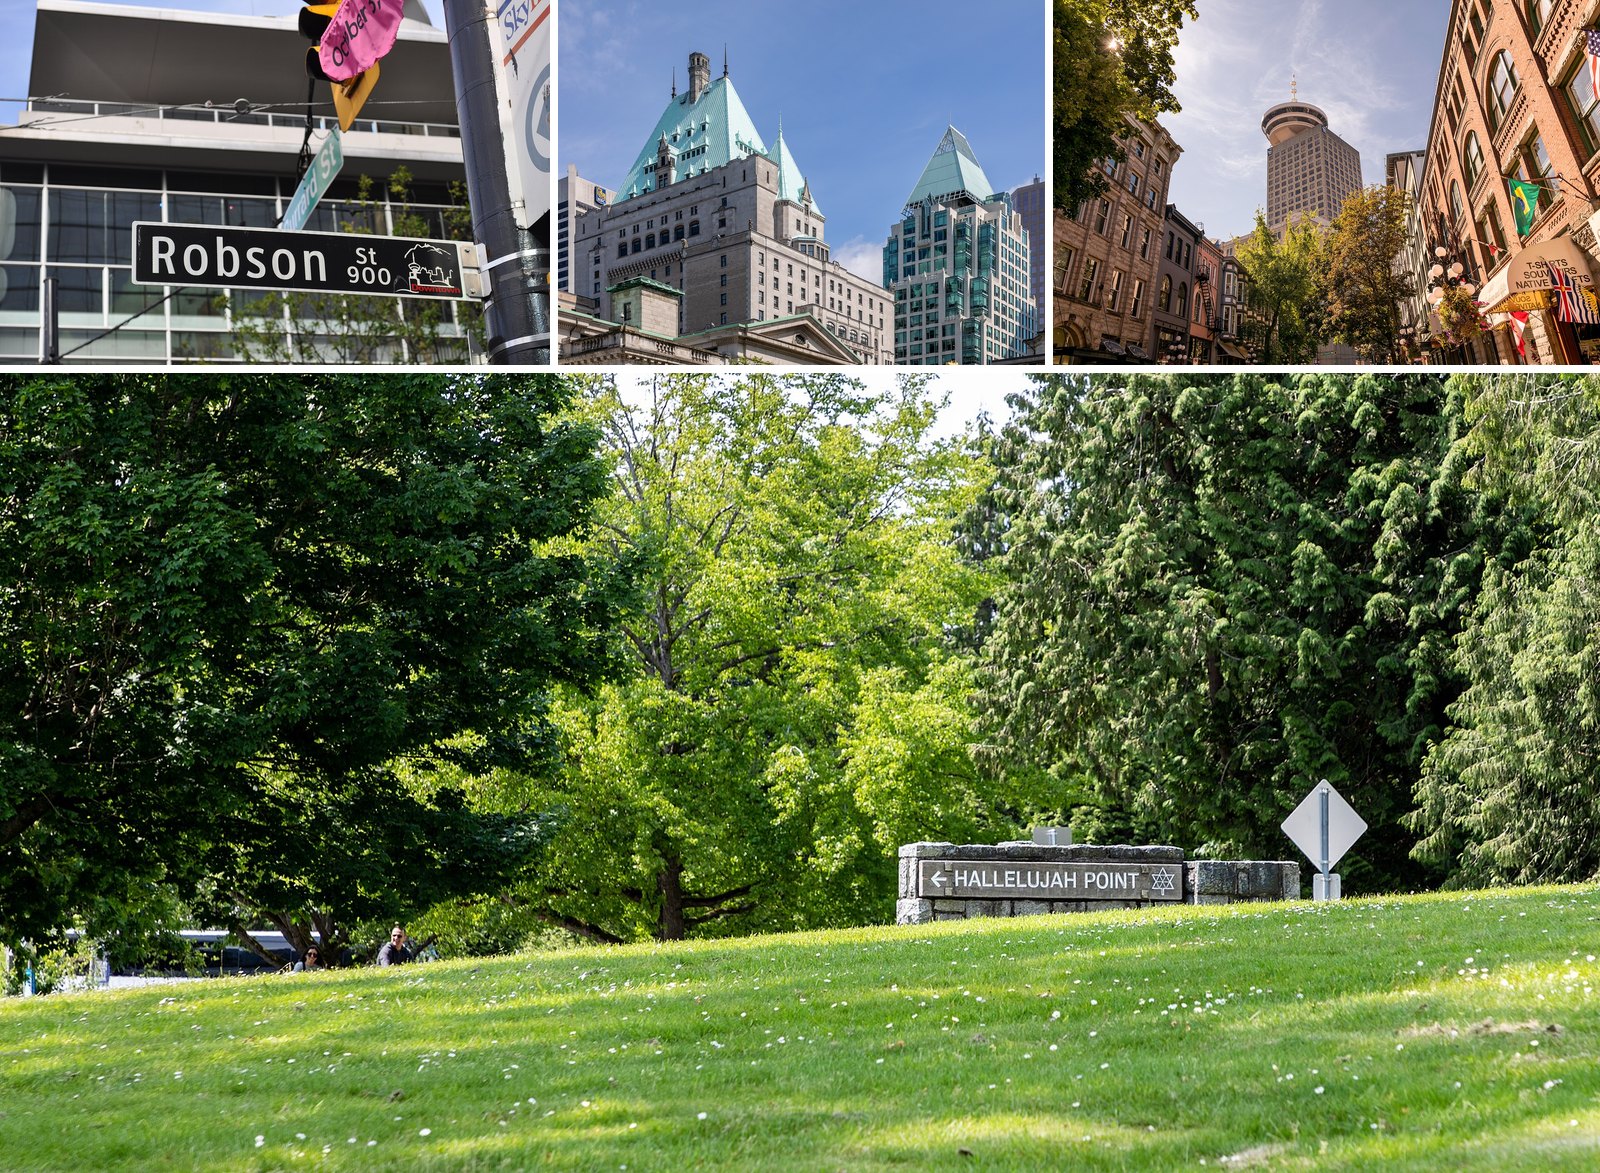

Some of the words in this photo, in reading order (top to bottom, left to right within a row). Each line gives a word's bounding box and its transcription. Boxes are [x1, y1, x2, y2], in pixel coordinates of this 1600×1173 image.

[321, 142, 337, 179] St
[151, 236, 327, 282] Robson
[355, 247, 378, 265] St
[346, 265, 392, 286] 900
[1515, 279, 1550, 289] NATIVE
[411, 283, 461, 294] Downtown
[954, 869, 1077, 889] HALLELUJAH
[1084, 871, 1140, 889] POINT
